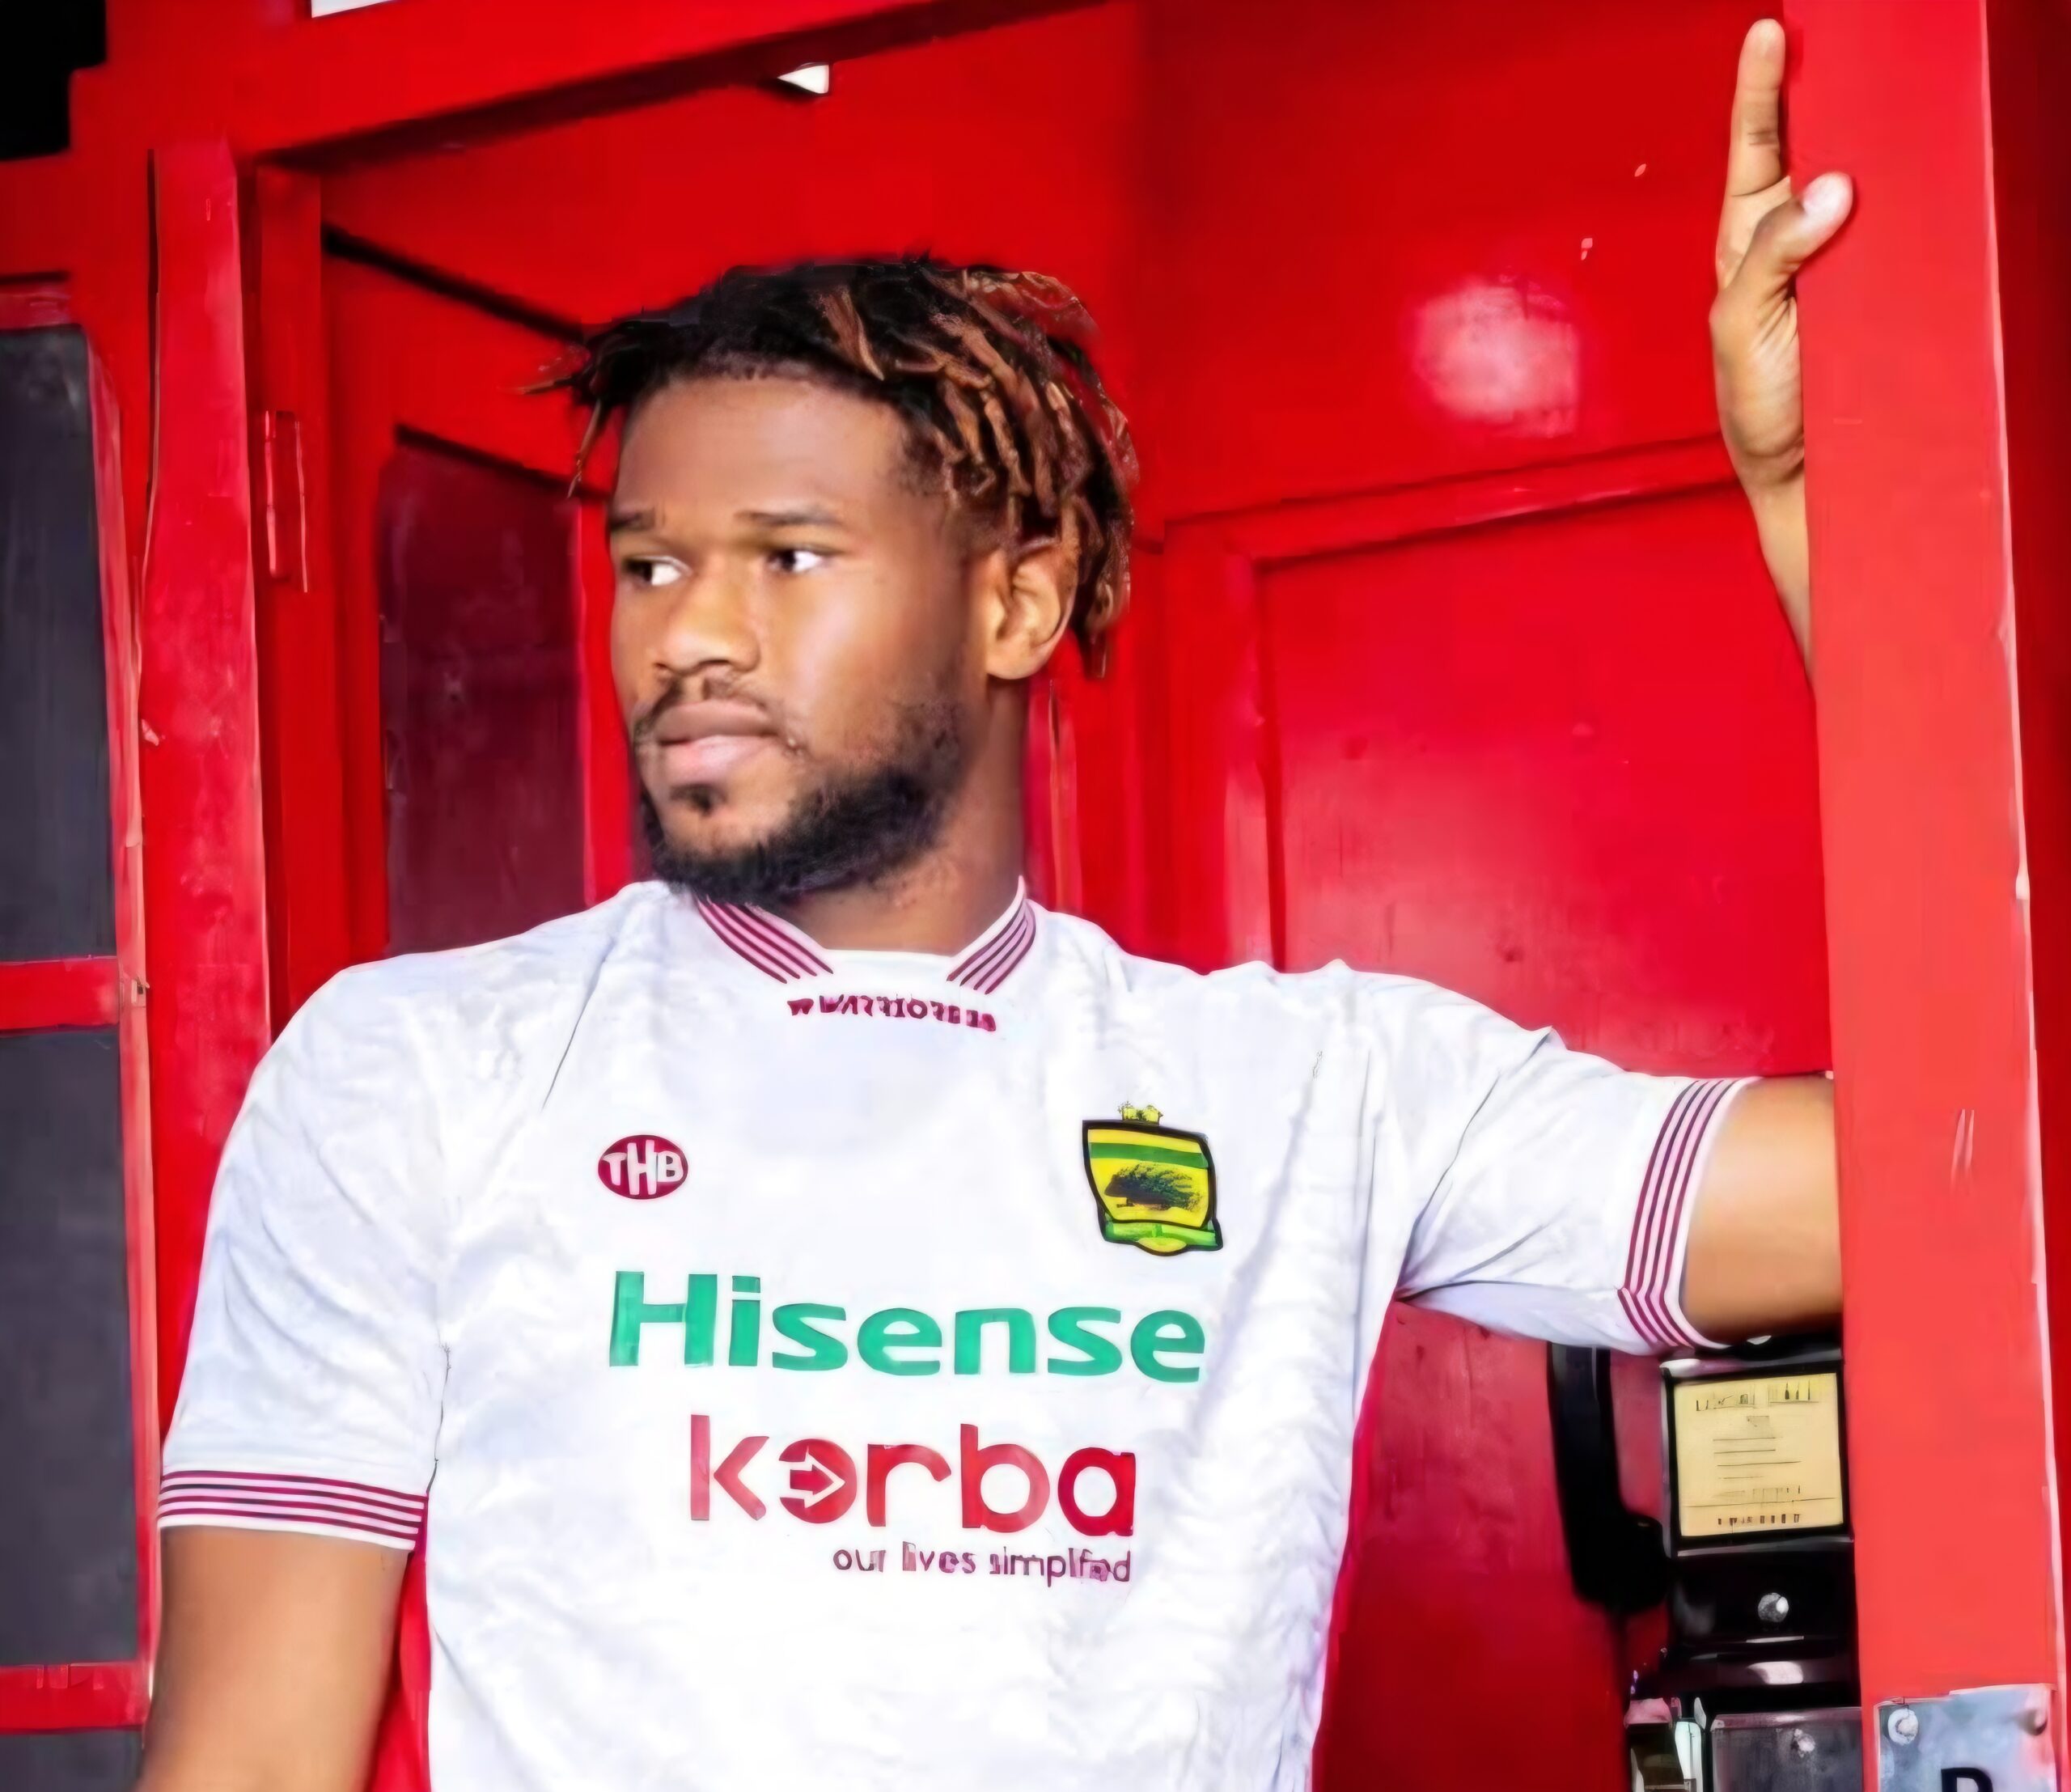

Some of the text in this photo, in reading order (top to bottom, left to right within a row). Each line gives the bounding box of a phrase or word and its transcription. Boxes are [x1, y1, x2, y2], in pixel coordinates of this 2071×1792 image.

[602, 1139, 684, 1195] THB
[609, 1271, 1205, 1383] Hisense
[690, 1414, 1137, 1537] korba
[832, 1548, 887, 1573] our
